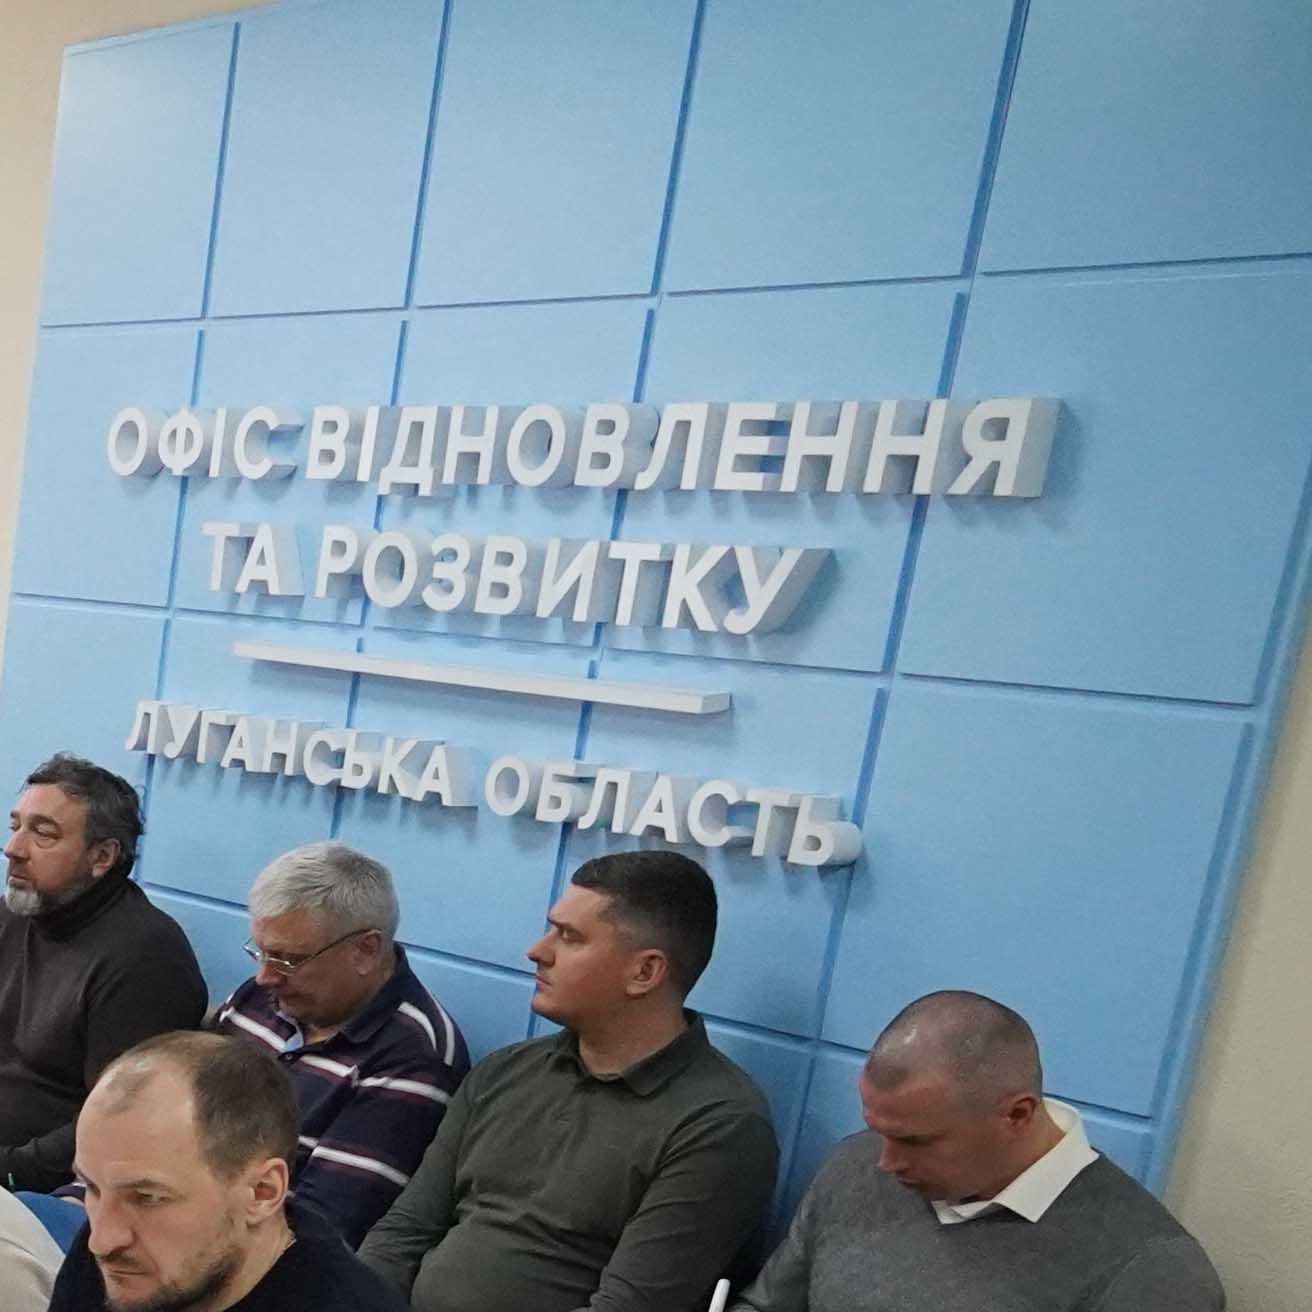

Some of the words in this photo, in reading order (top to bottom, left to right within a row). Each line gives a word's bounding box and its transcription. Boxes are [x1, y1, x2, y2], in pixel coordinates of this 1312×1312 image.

[106, 404, 284, 481] ОФІС
[305, 397, 1040, 498] ВІДНОВЛЕННЯ
[200, 521, 286, 597] ТА
[314, 523, 816, 637] РОЗВИТКУ
[125, 698, 461, 808] ЛУГАНСЬКА
[485, 752, 856, 868] ОБЛАСТЬ
